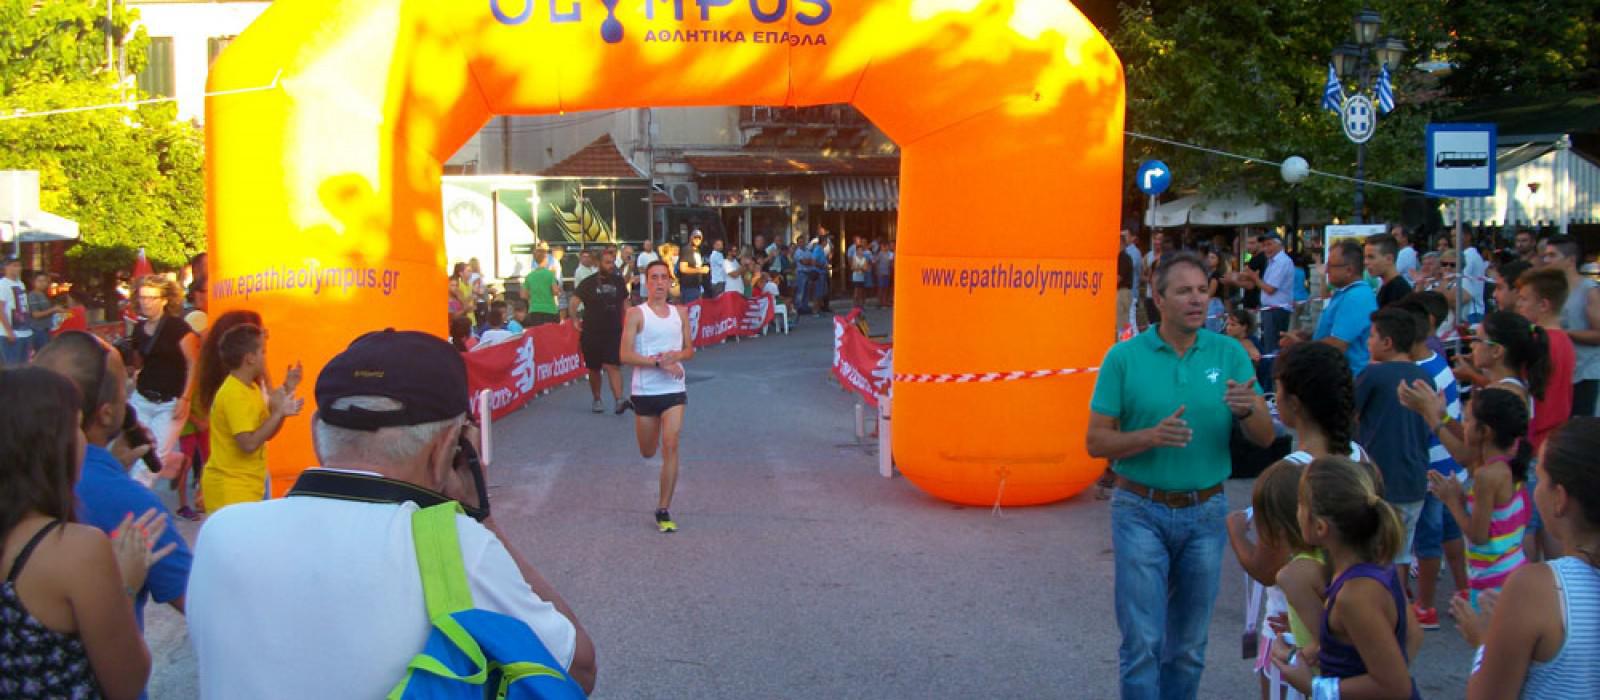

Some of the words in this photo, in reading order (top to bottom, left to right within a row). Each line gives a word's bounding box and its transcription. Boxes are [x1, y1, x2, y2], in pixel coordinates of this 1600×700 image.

[644, 29, 746, 43] ΑΘΛΗΤΙΚΑ
[211, 264, 400, 300] www.epathlaolympus.gr
[921, 264, 1103, 296] www.epathlaolympus.gr
